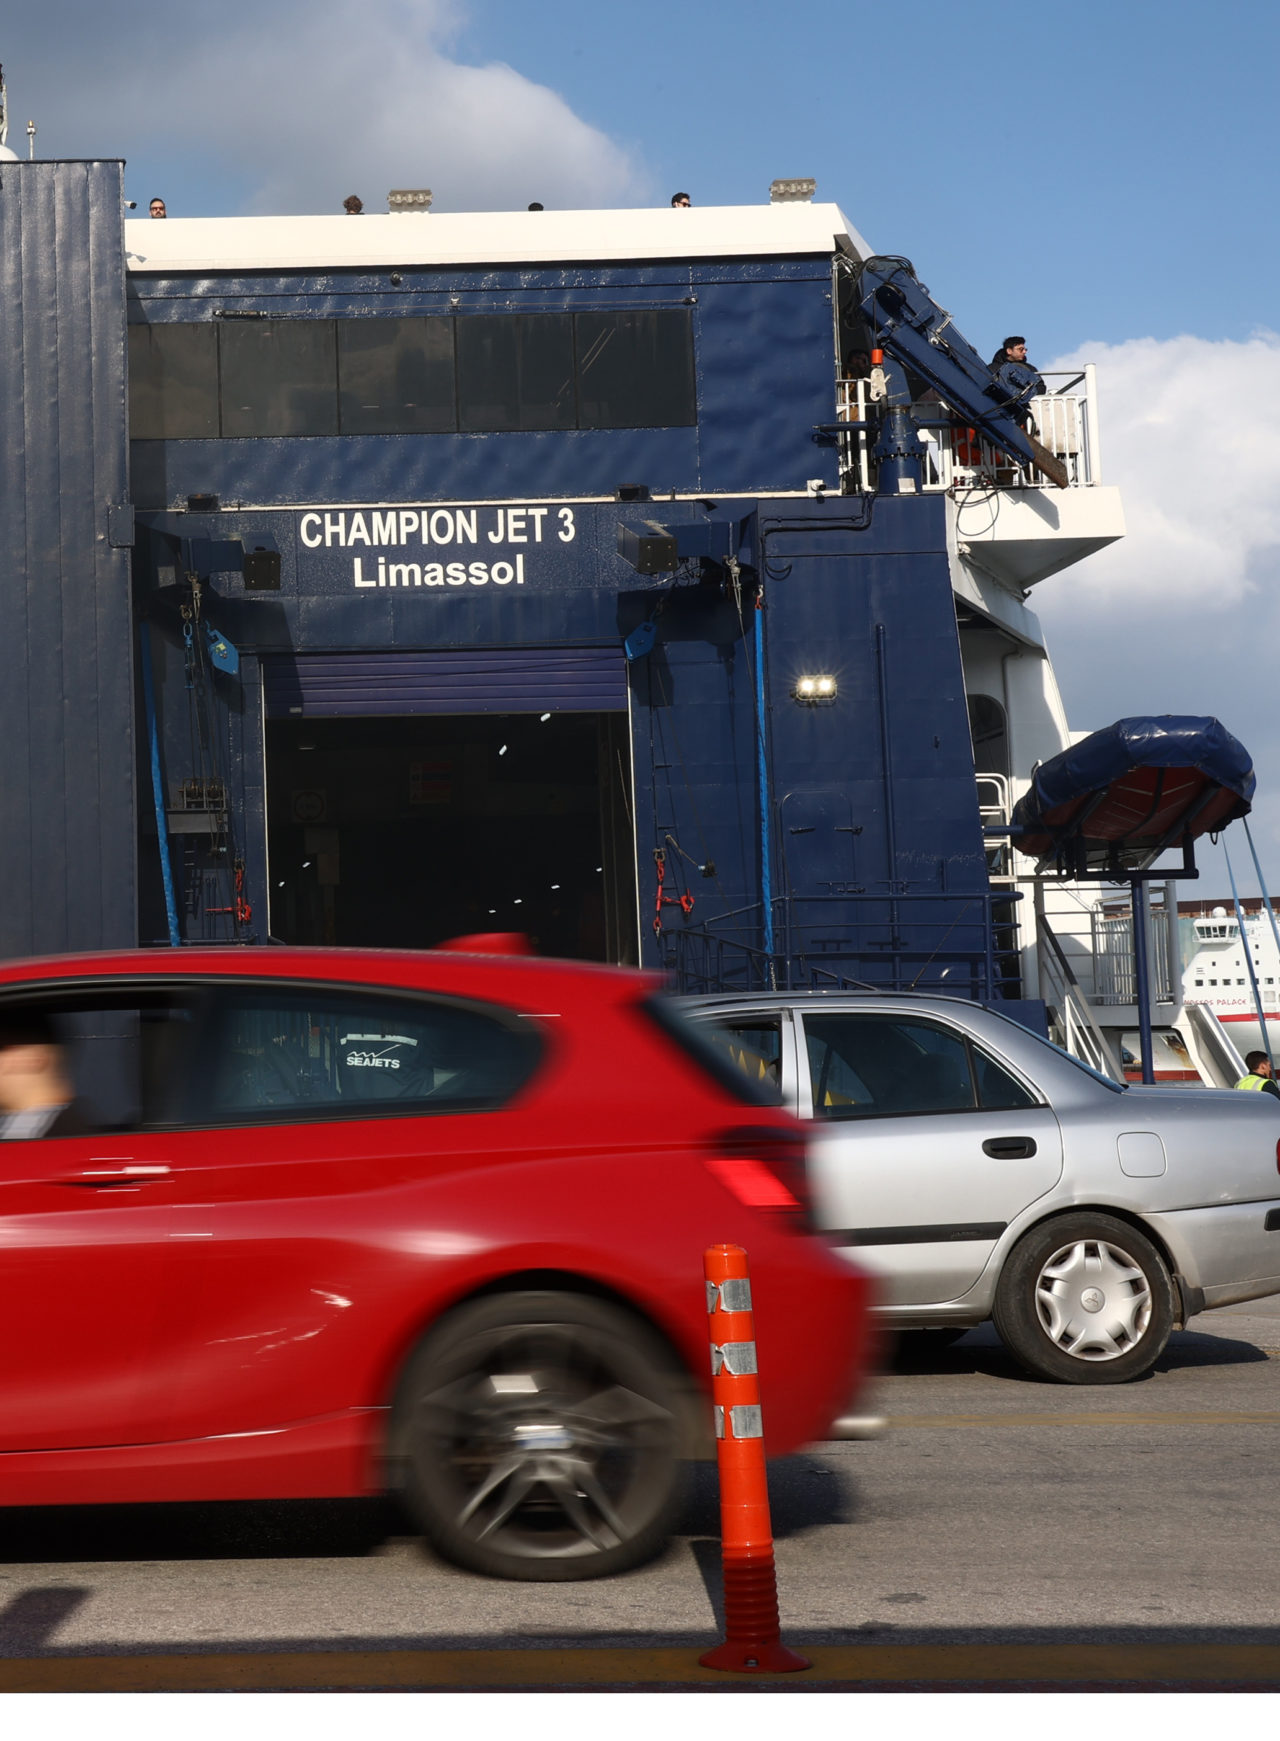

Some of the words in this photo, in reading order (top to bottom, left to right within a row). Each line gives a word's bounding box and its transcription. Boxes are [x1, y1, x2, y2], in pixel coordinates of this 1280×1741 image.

[299, 509, 478, 548] CHAMPION
[487, 507, 548, 544] JET
[557, 507, 576, 542] 3
[353, 553, 525, 588] Limassol
[346, 1056, 401, 1069] SEAJETS
